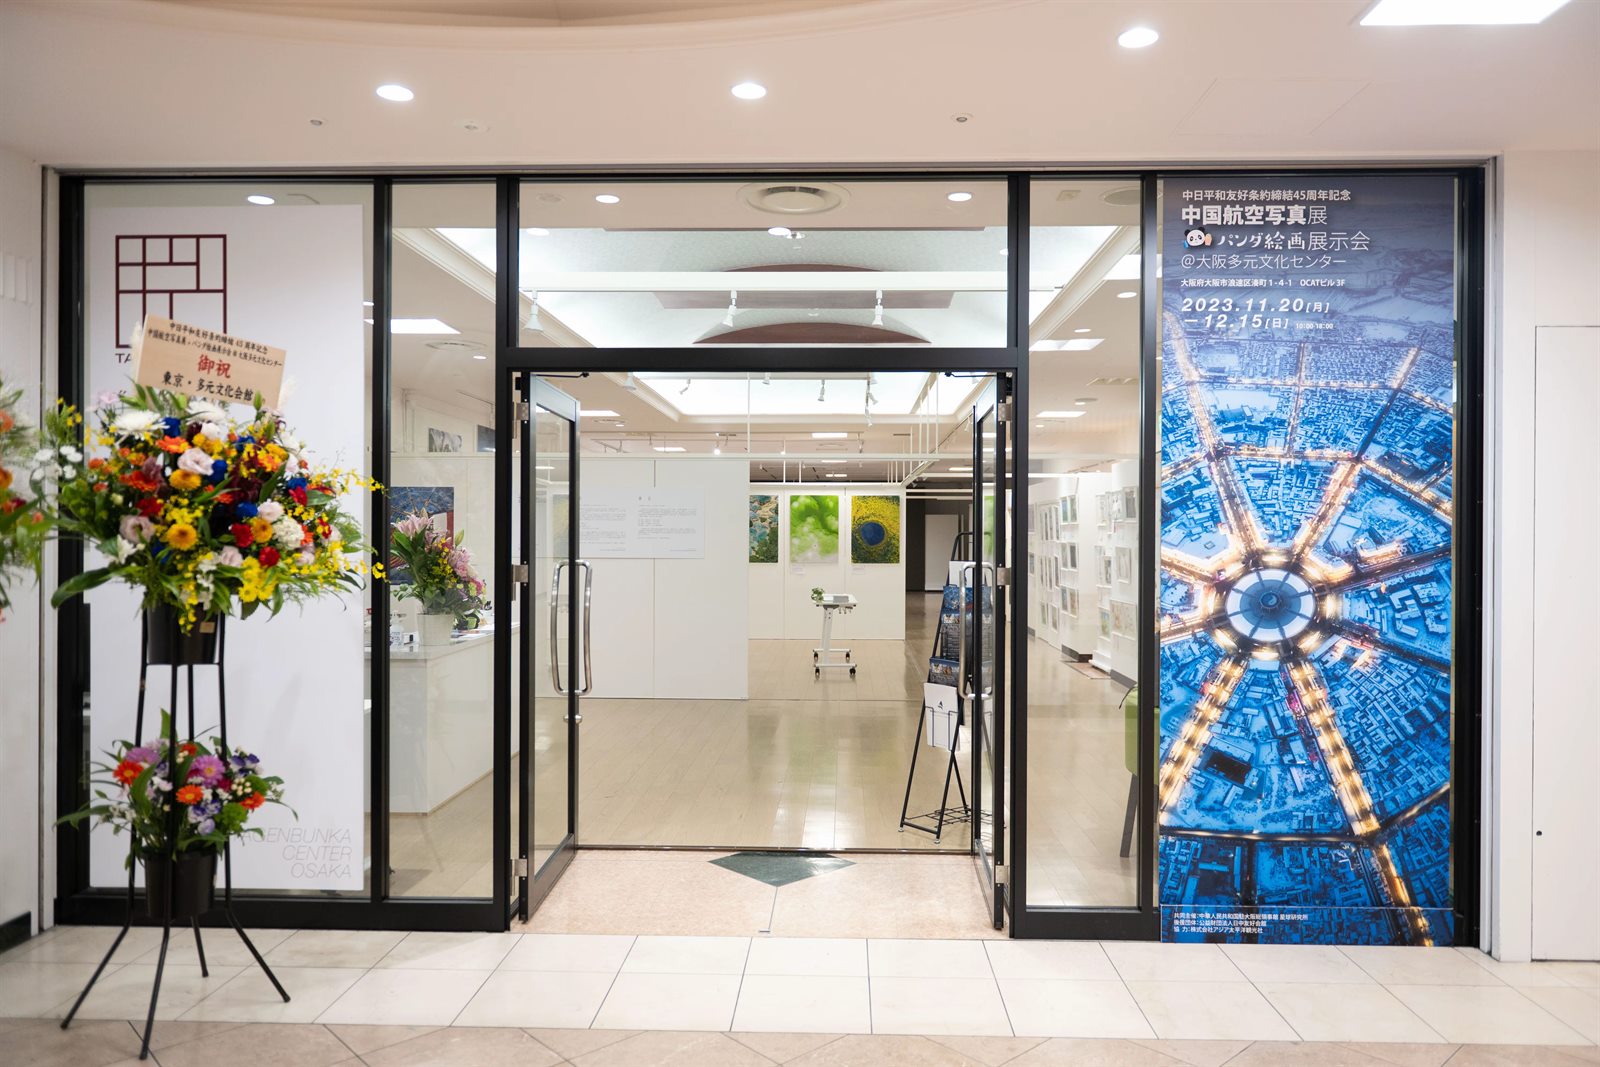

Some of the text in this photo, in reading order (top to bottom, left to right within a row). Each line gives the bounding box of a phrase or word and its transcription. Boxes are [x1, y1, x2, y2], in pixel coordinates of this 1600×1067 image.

[1182, 189, 1352, 201] 中日平和友好条約締結45周年記念
[1181, 204, 1328, 226] 中国航空写真展
[1217, 230, 1371, 251] パンダ絵画展示会
[1181, 253, 1347, 270] @大阪多元文化センター
[197, 354, 231, 379] 御祝
[282, 844, 353, 861] CENTER
[290, 862, 352, 878] OSAKA
